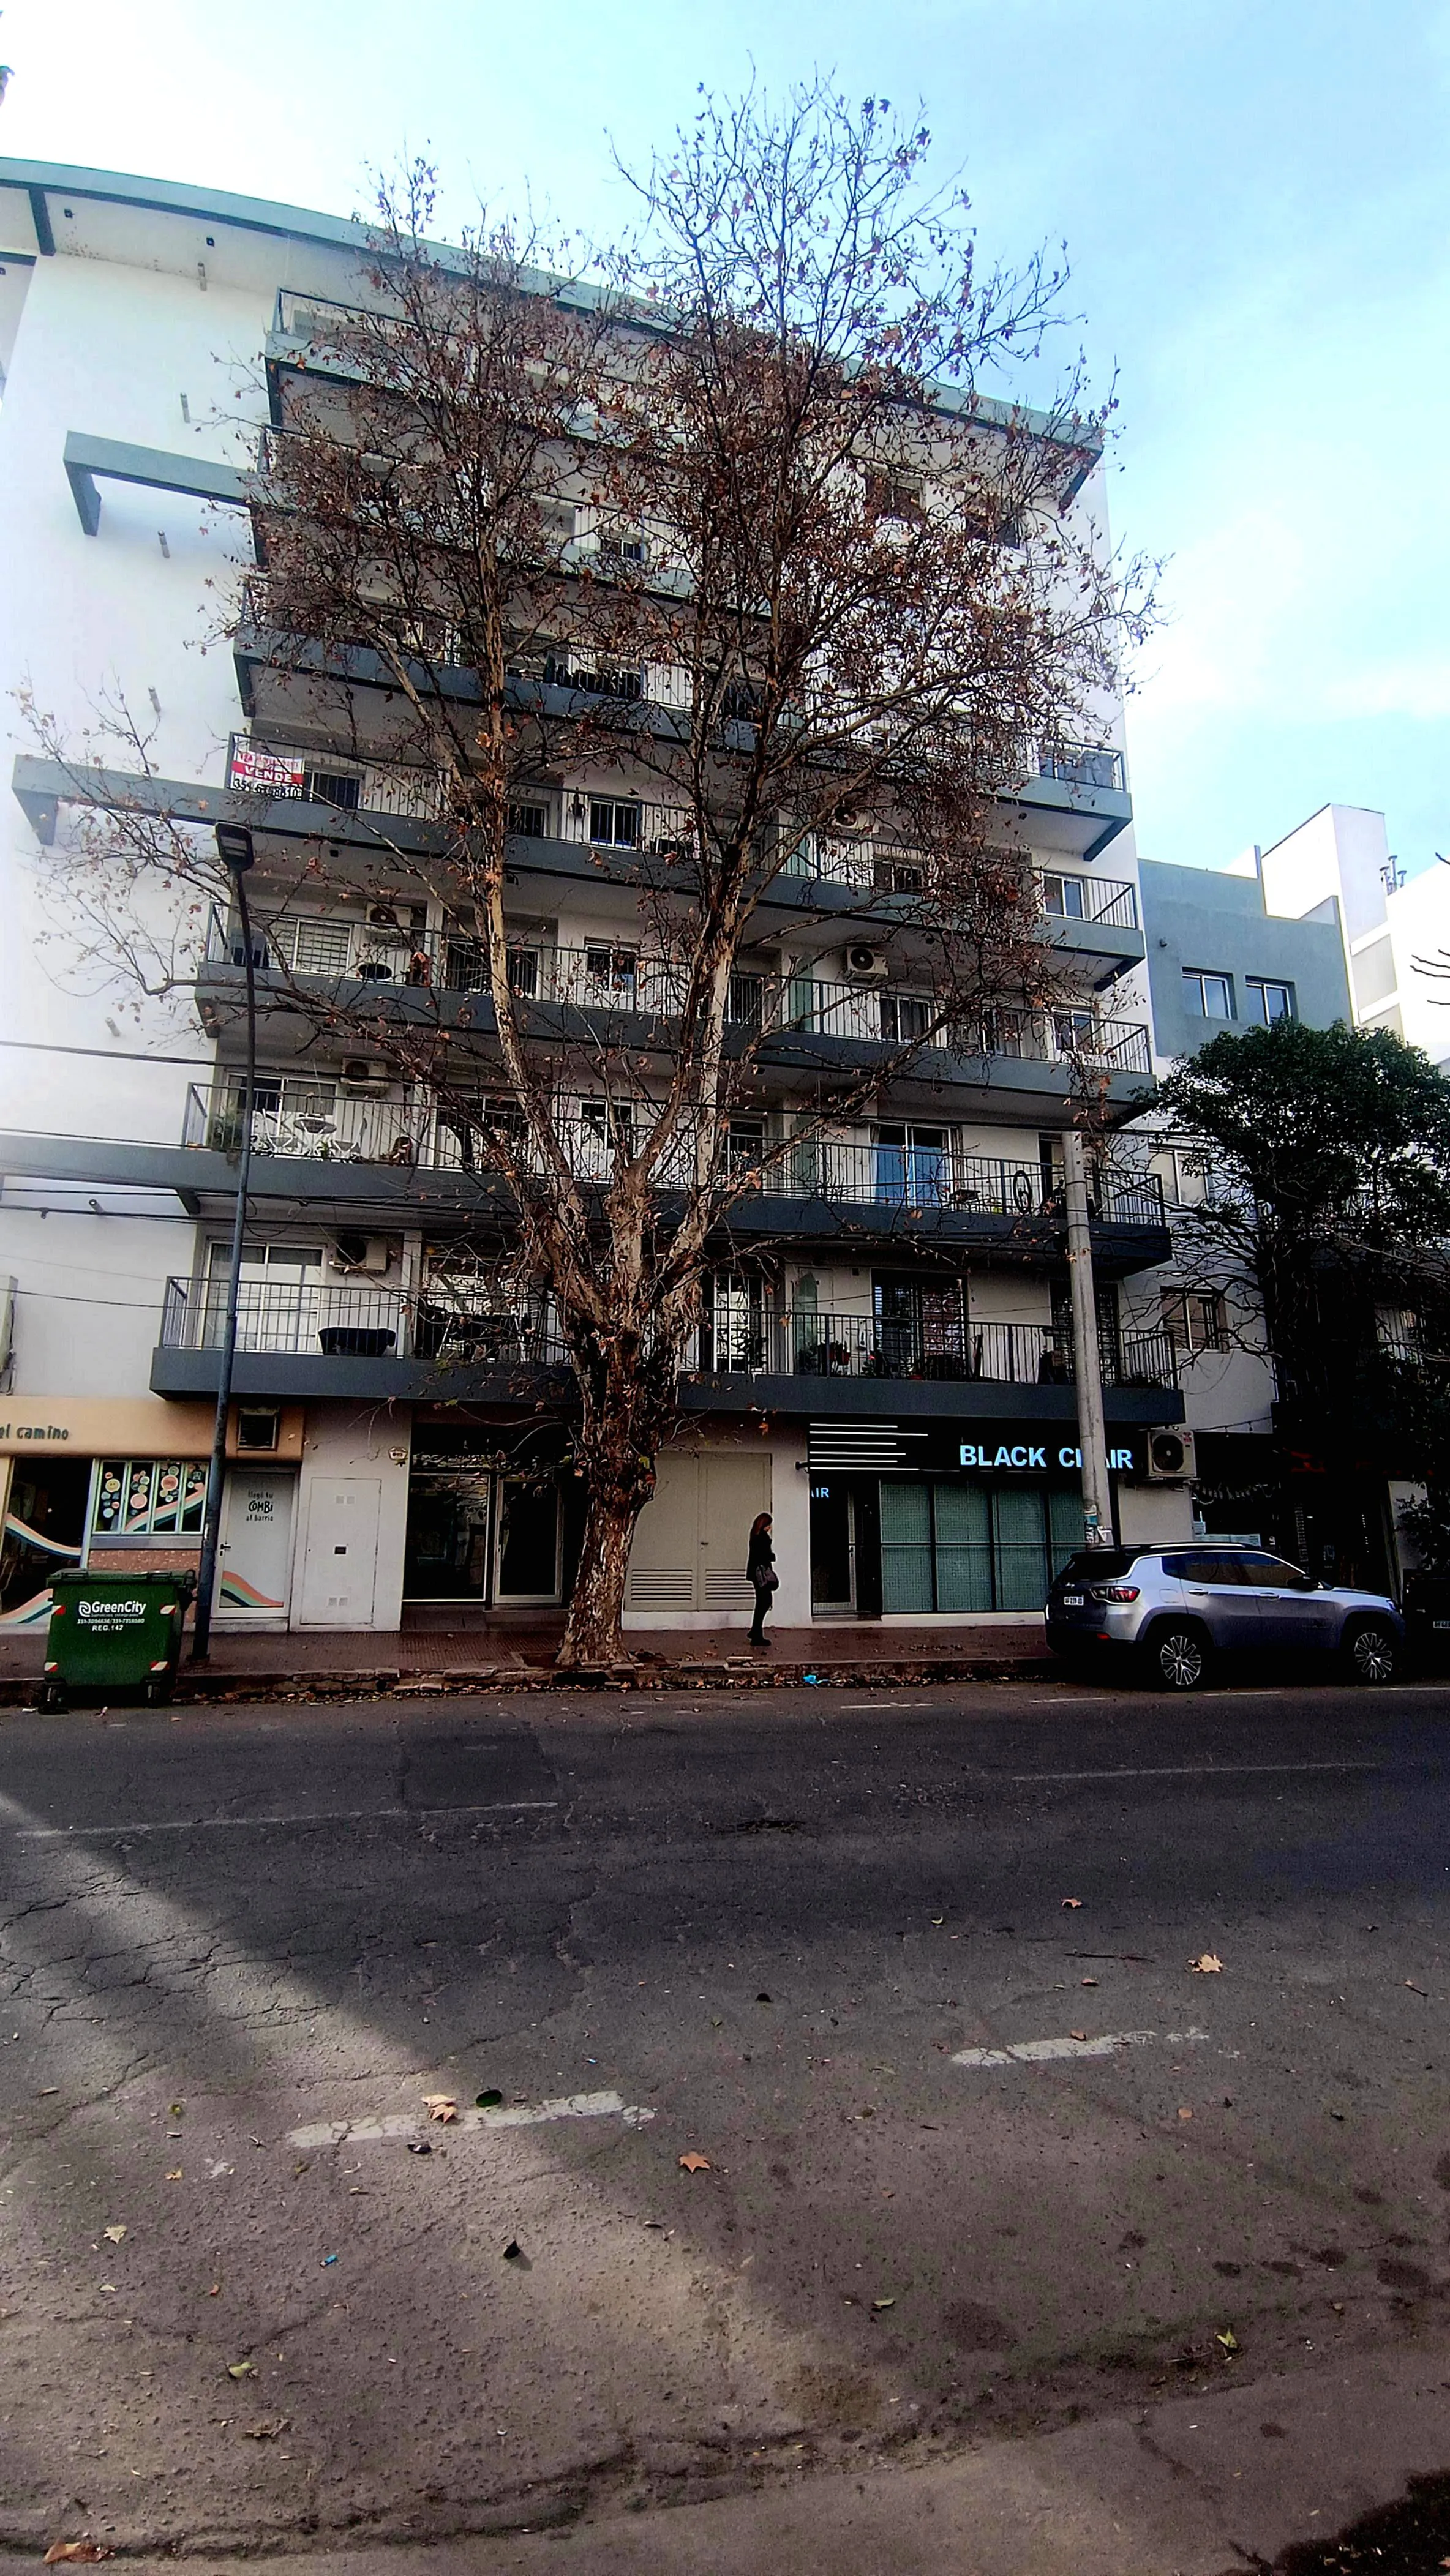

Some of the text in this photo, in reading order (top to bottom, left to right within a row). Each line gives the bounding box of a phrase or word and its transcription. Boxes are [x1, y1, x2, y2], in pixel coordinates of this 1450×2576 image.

[245, 766, 293, 783] VENDE
[17, 1425, 69, 1440] camino
[960, 1445, 1133, 1469] BLACK CIR
[92, 1601, 146, 1615] GreenCity
